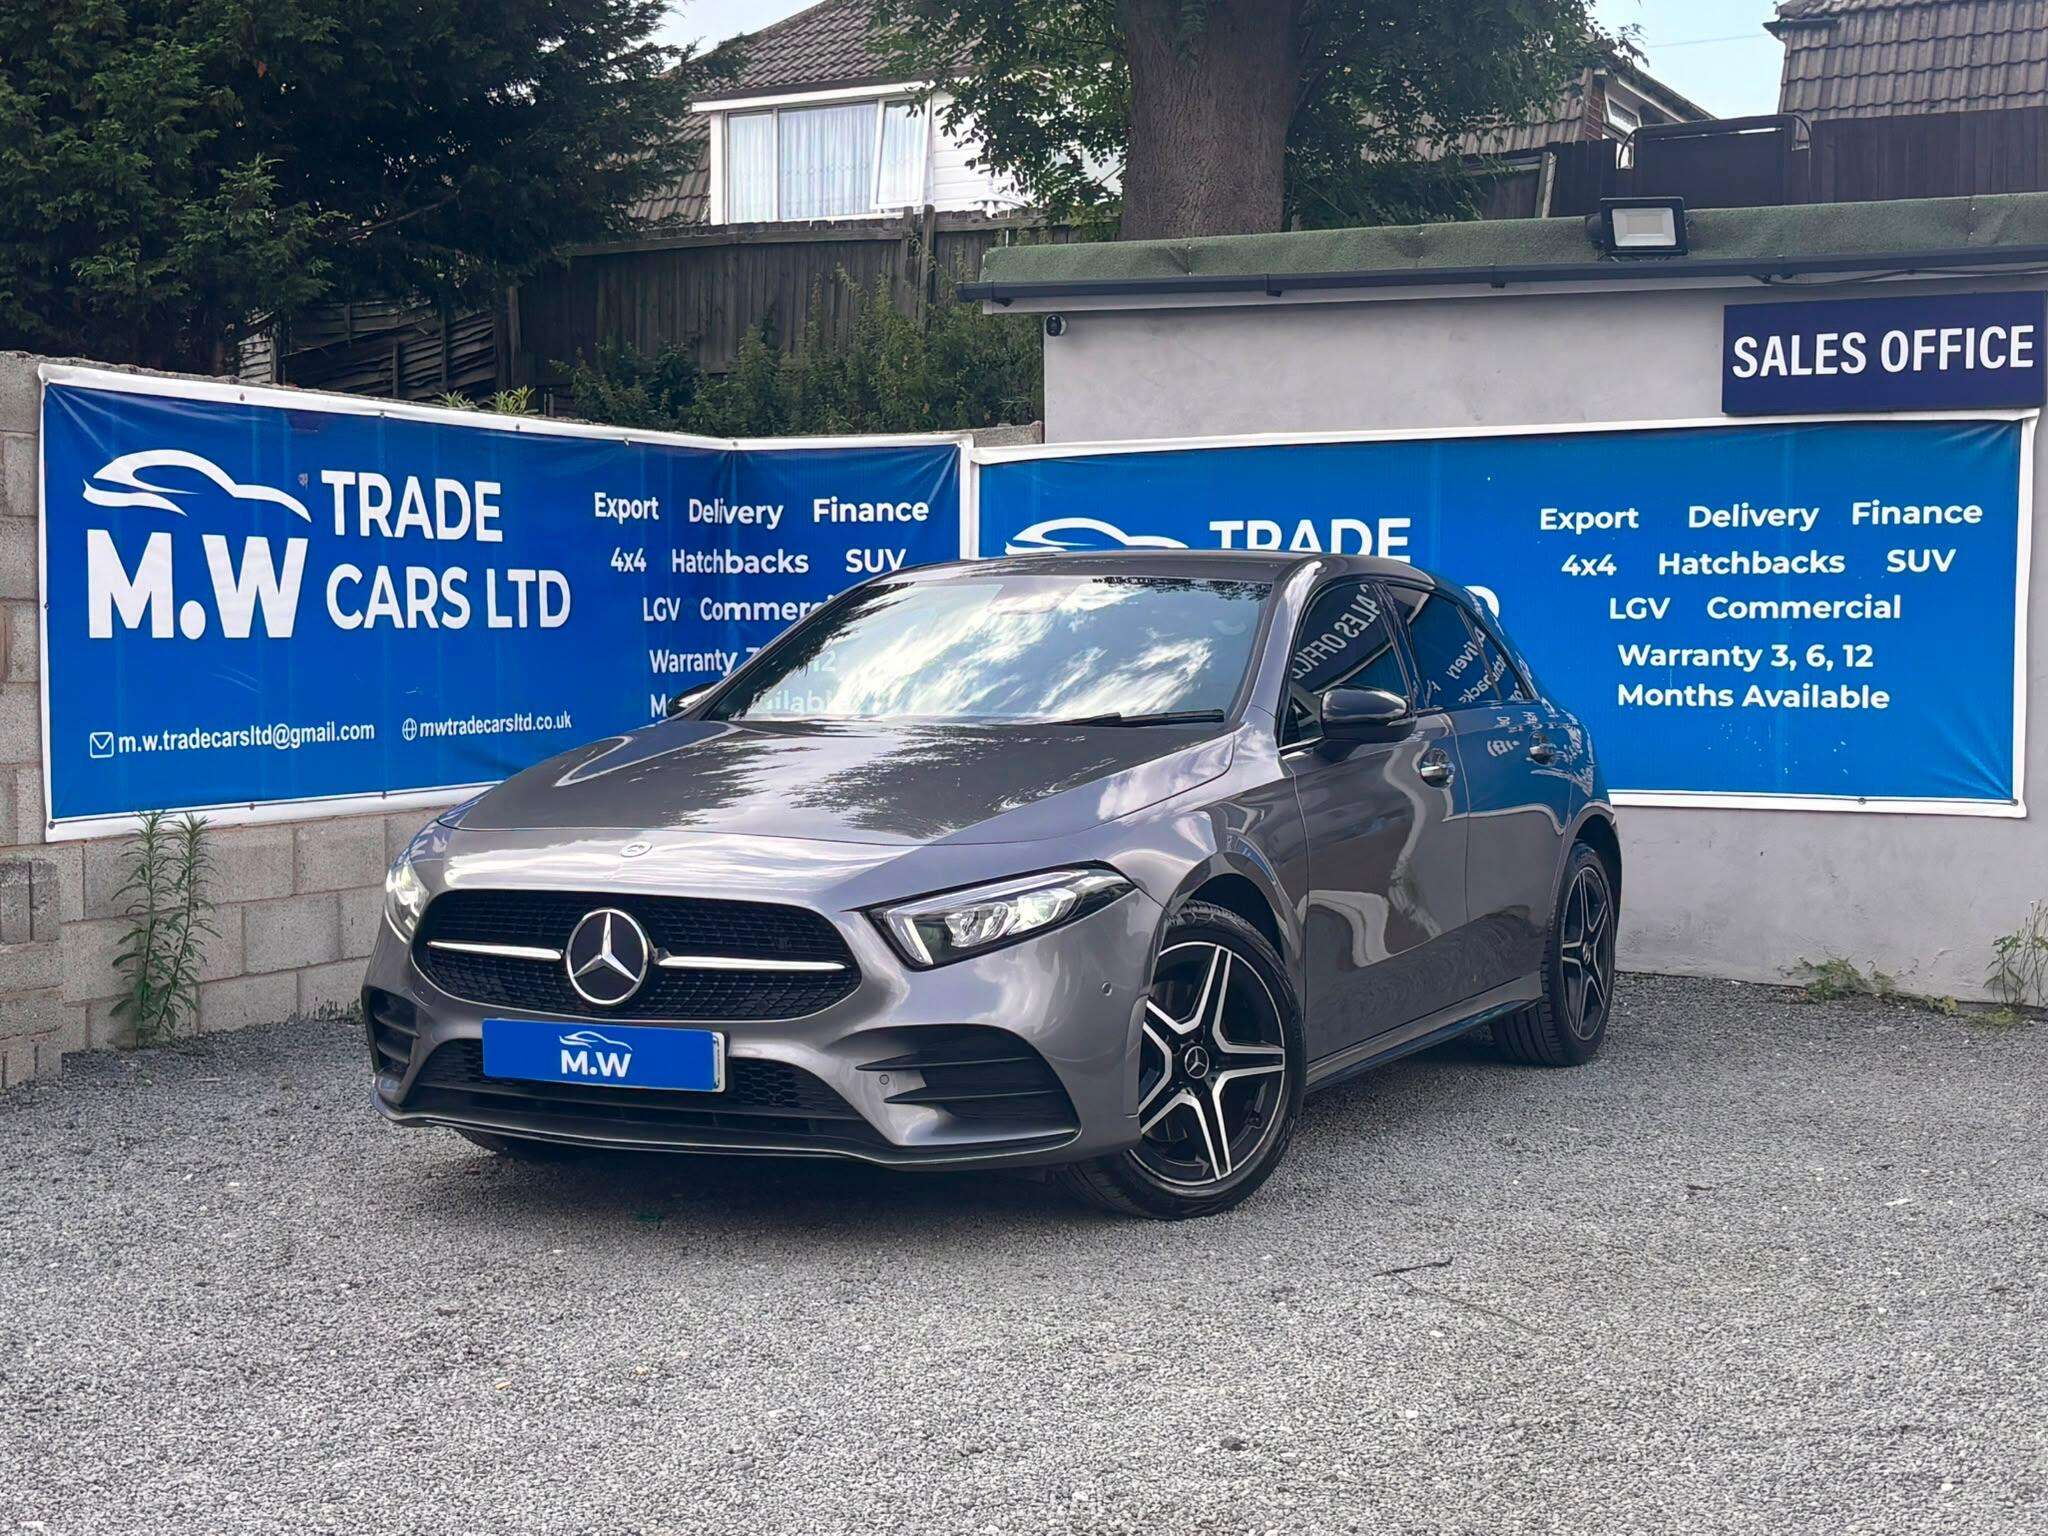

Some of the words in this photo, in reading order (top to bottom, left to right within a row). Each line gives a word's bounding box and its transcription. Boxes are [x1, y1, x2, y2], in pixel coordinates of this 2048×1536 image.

[1732, 331, 1867, 378] SALES
[1880, 324, 2034, 373] OFFICE
[321, 469, 503, 542] TRADE
[594, 492, 659, 525] Export
[689, 498, 784, 530] Delivery
[813, 496, 929, 523] Finance
[1540, 507, 1639, 535] Export
[1688, 502, 1819, 532] Delivery
[1852, 499, 1983, 525] Finance
[1208, 517, 1411, 562] TRADE
[610, 547, 647, 572] 4x4
[672, 548, 809, 574] Hatchbacks
[845, 548, 907, 573] SUV
[1561, 554, 1617, 576] 4x4
[1659, 549, 1846, 575] Hatchbacks
[1887, 549, 1956, 573] SUV
[87, 529, 309, 640] M.W
[326, 563, 471, 630] CARS
[486, 568, 571, 628] LTD
[643, 597, 681, 622] LGV
[1610, 597, 1671, 620] LGV
[1707, 593, 1901, 619] Commercial
[649, 649, 738, 676] Warranty
[1618, 644, 1763, 673] Warranty
[1771, 644, 1797, 671] 3,
[1806, 644, 1834, 672] 6,
[1842, 644, 1874, 668] 12
[1618, 683, 1734, 707] Months
[1742, 682, 1890, 709] Available
[118, 721, 375, 754] m.w.tradecarsltd@gmail.com
[420, 711, 572, 738] mwtradecarsltd.co.uk
[561, 1049, 632, 1078] M.W
